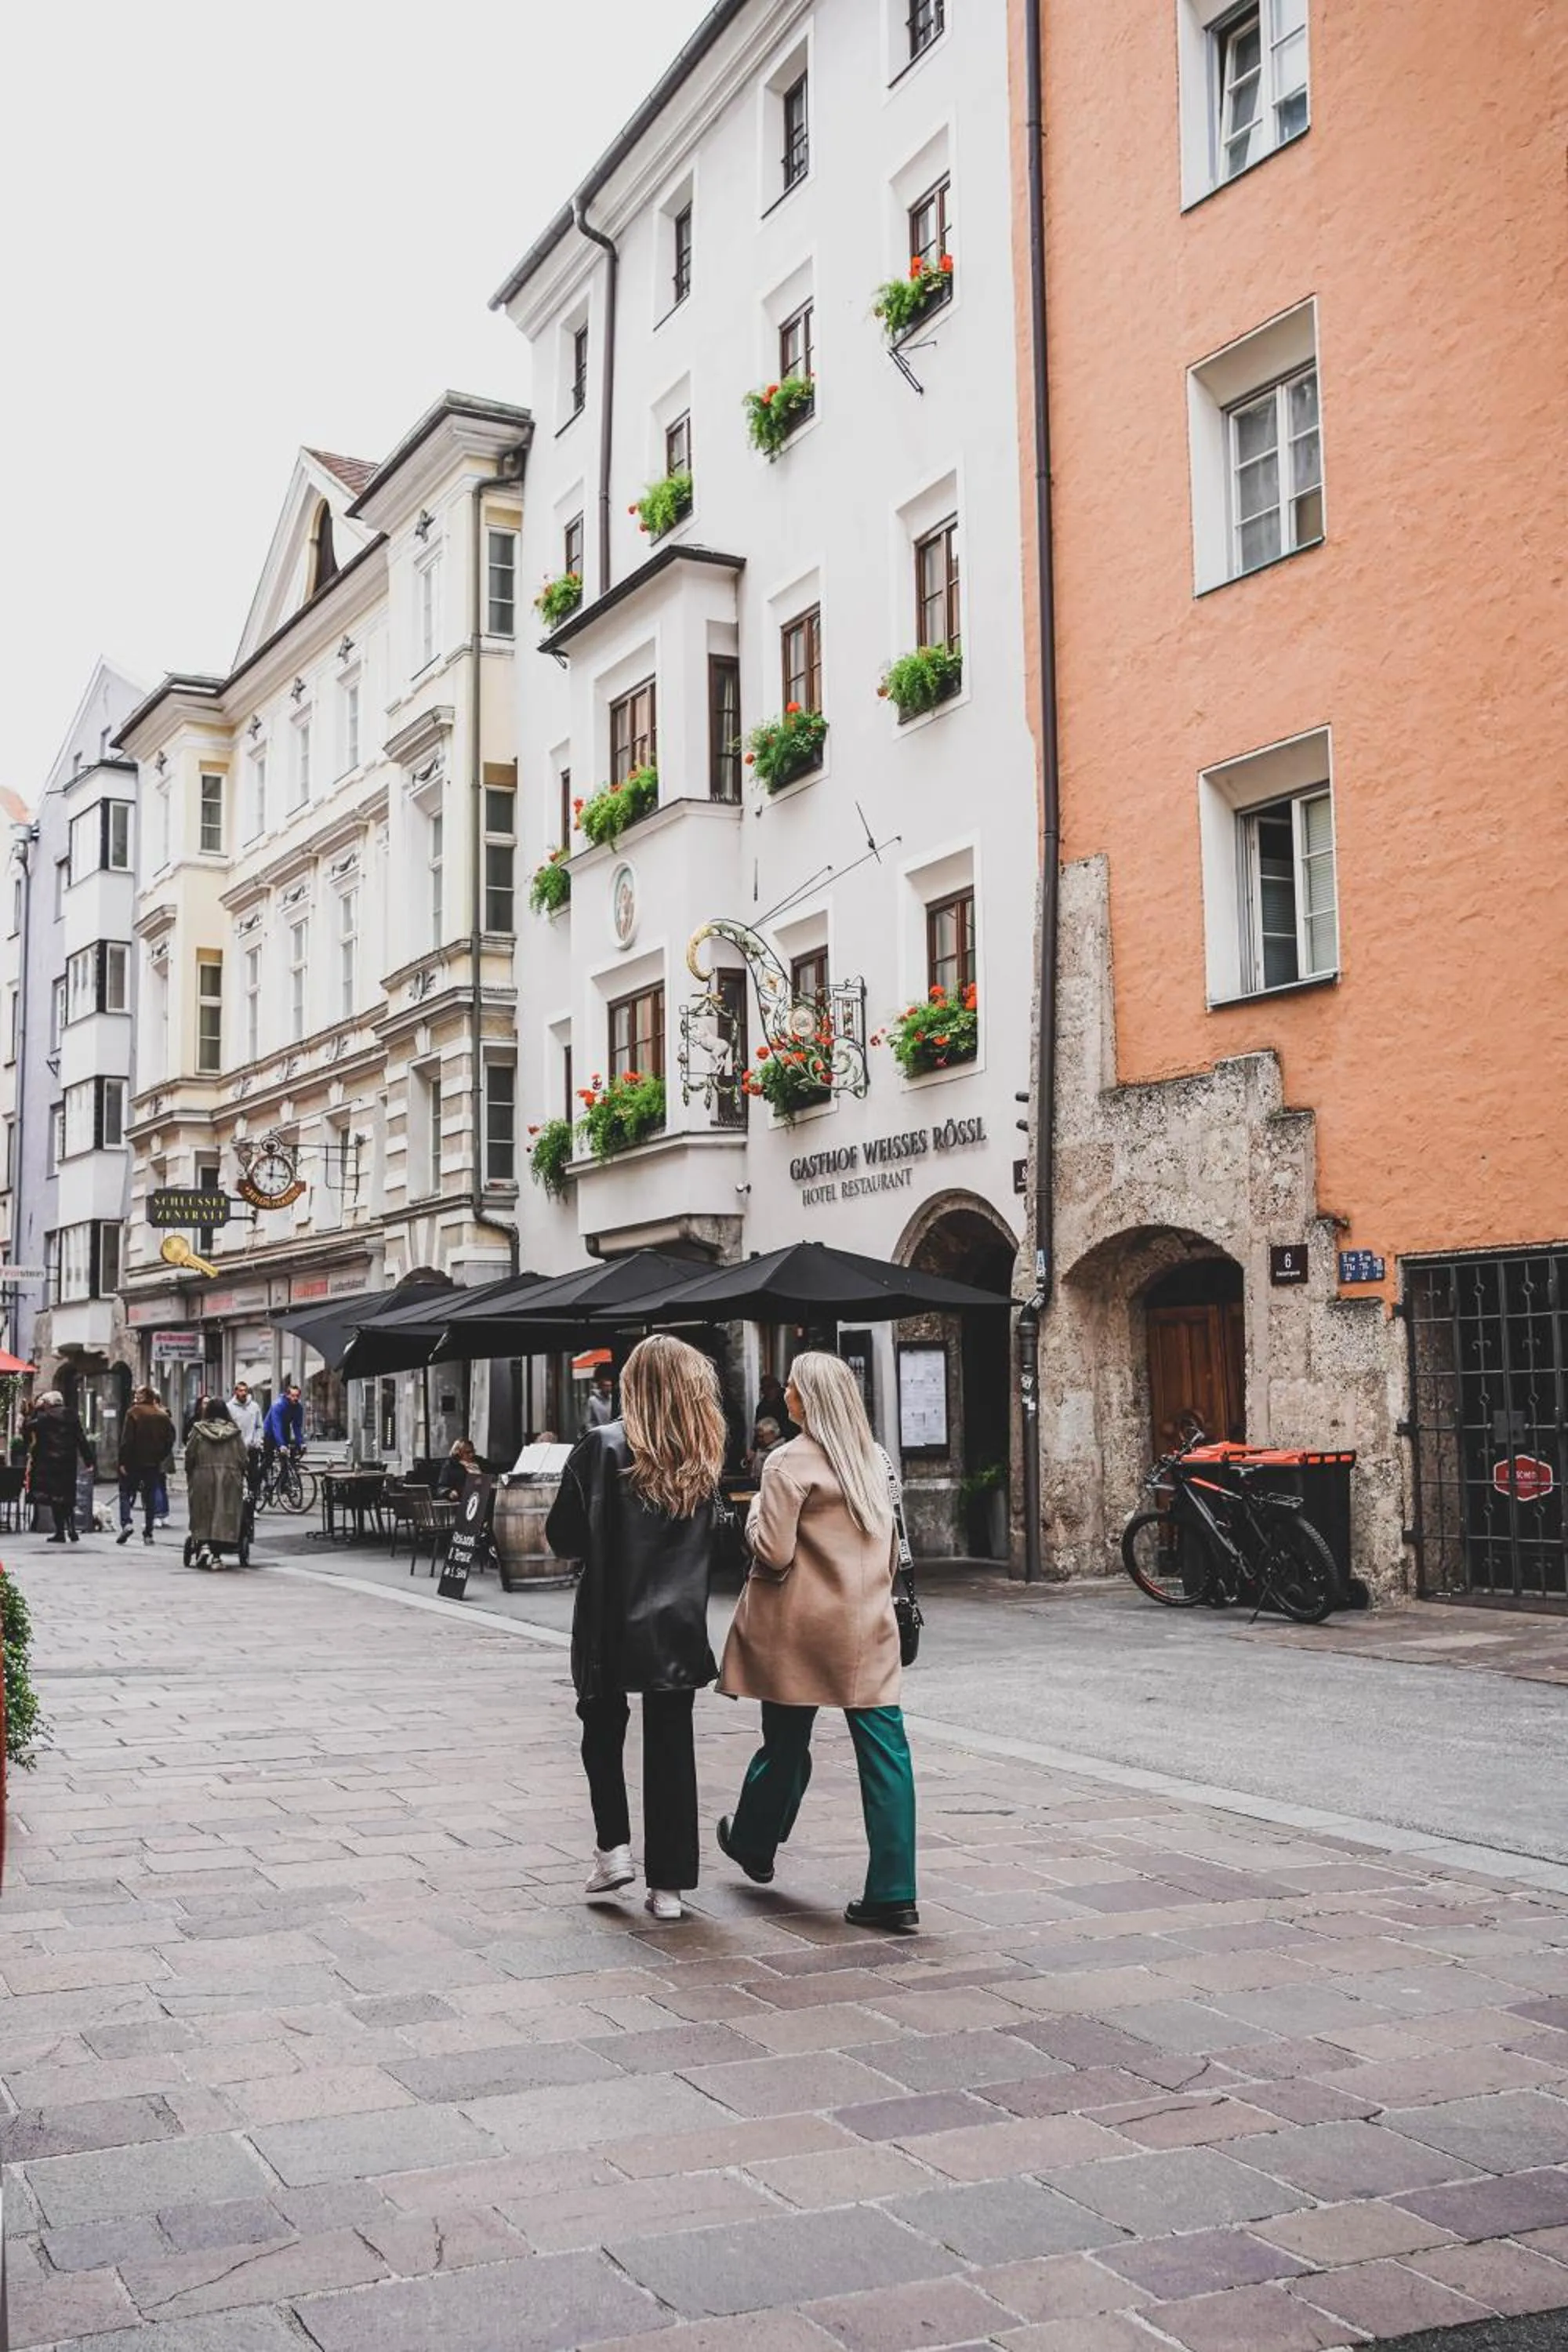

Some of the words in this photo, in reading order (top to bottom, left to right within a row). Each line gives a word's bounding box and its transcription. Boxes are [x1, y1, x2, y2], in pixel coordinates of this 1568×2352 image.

[789, 1145, 858, 1180] GASTHOF
[862, 1129, 927, 1165] WEISSES
[932, 1116, 986, 1150] RÖSSL
[802, 1182, 837, 1207] HOTEL
[841, 1167, 913, 1197] RESTAURANT
[157, 1210, 225, 1221] ZENTRALE
[1285, 1253, 1291, 1269] 6
